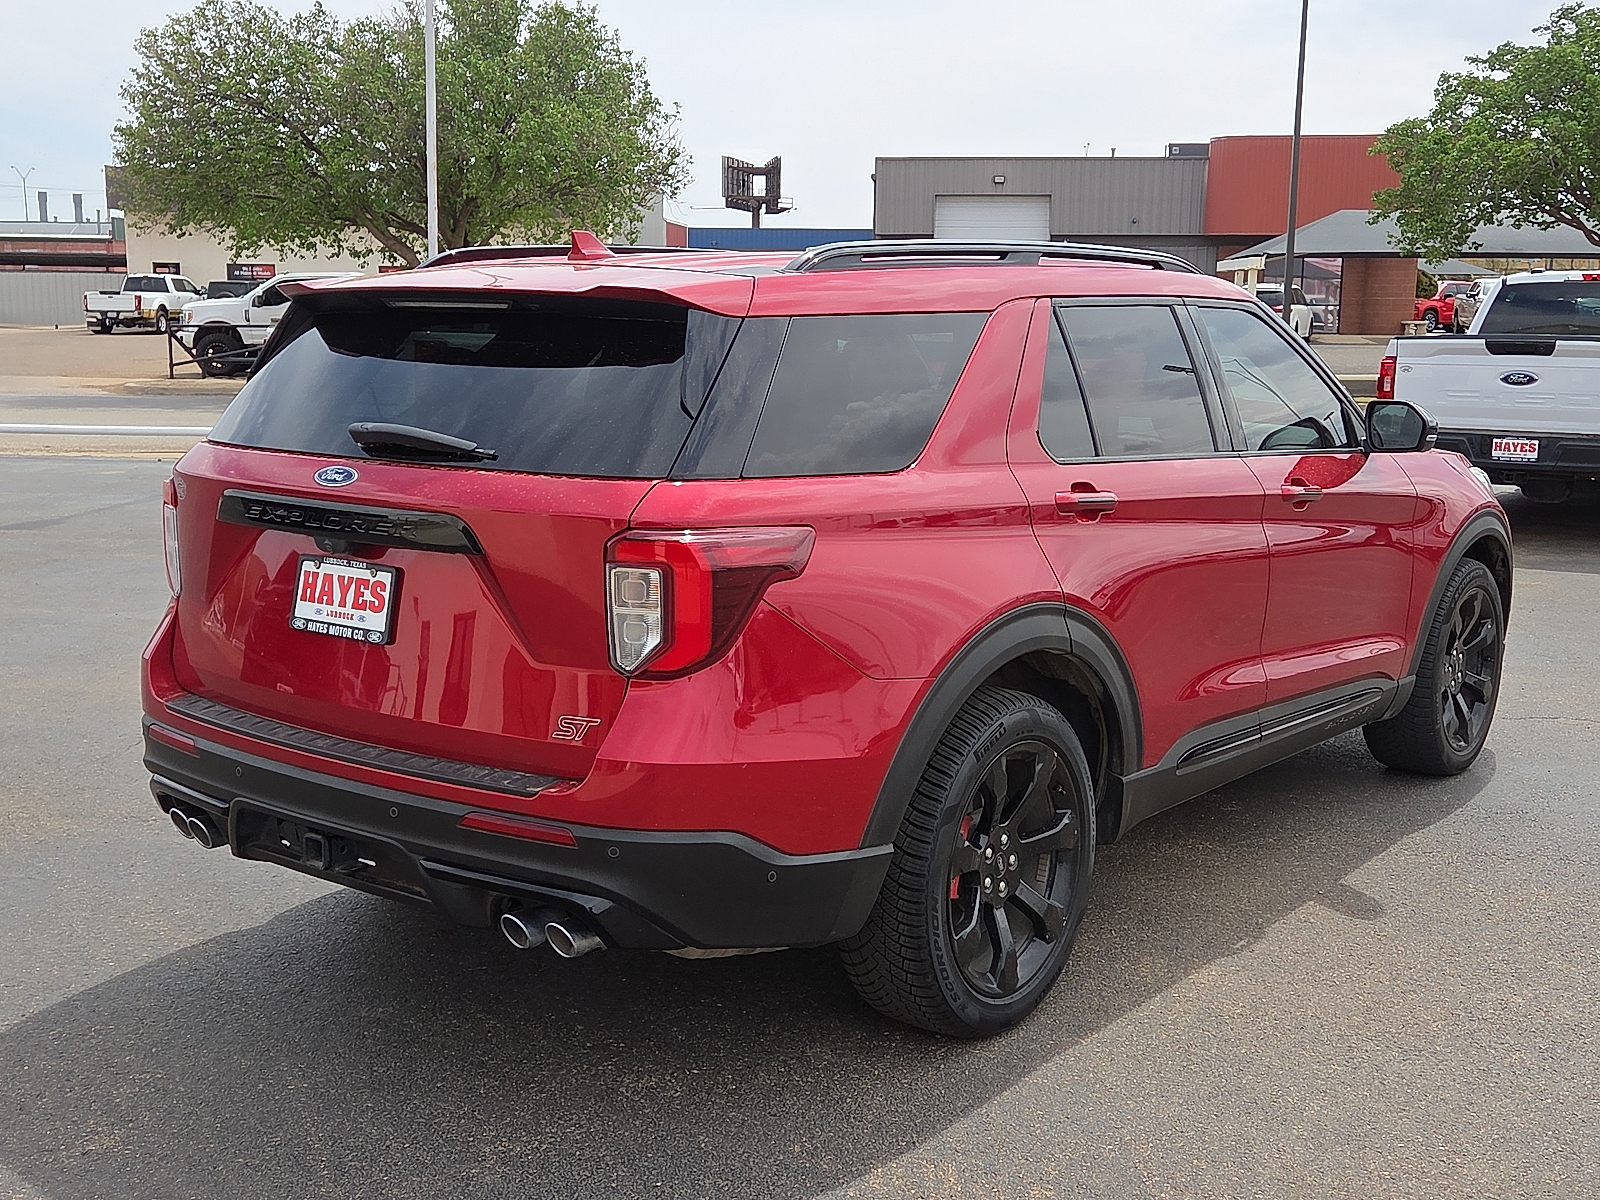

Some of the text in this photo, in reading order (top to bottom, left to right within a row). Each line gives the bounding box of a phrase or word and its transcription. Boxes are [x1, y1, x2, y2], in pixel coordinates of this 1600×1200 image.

[1508, 374, 1529, 383] Ford
[1493, 441, 1537, 453] HAYES
[321, 468, 347, 481] Ford
[244, 503, 417, 540] EXPLORER
[323, 556, 367, 569] LUBBOCK, TEXAS
[300, 569, 387, 614] HAYES
[326, 609, 355, 621] LUBBOCK
[307, 620, 328, 634] HAYES
[329, 624, 352, 638] MOTOR
[353, 629, 365, 641] CO.
[551, 715, 601, 741] ST
[931, 896, 961, 1003] SCORPION
